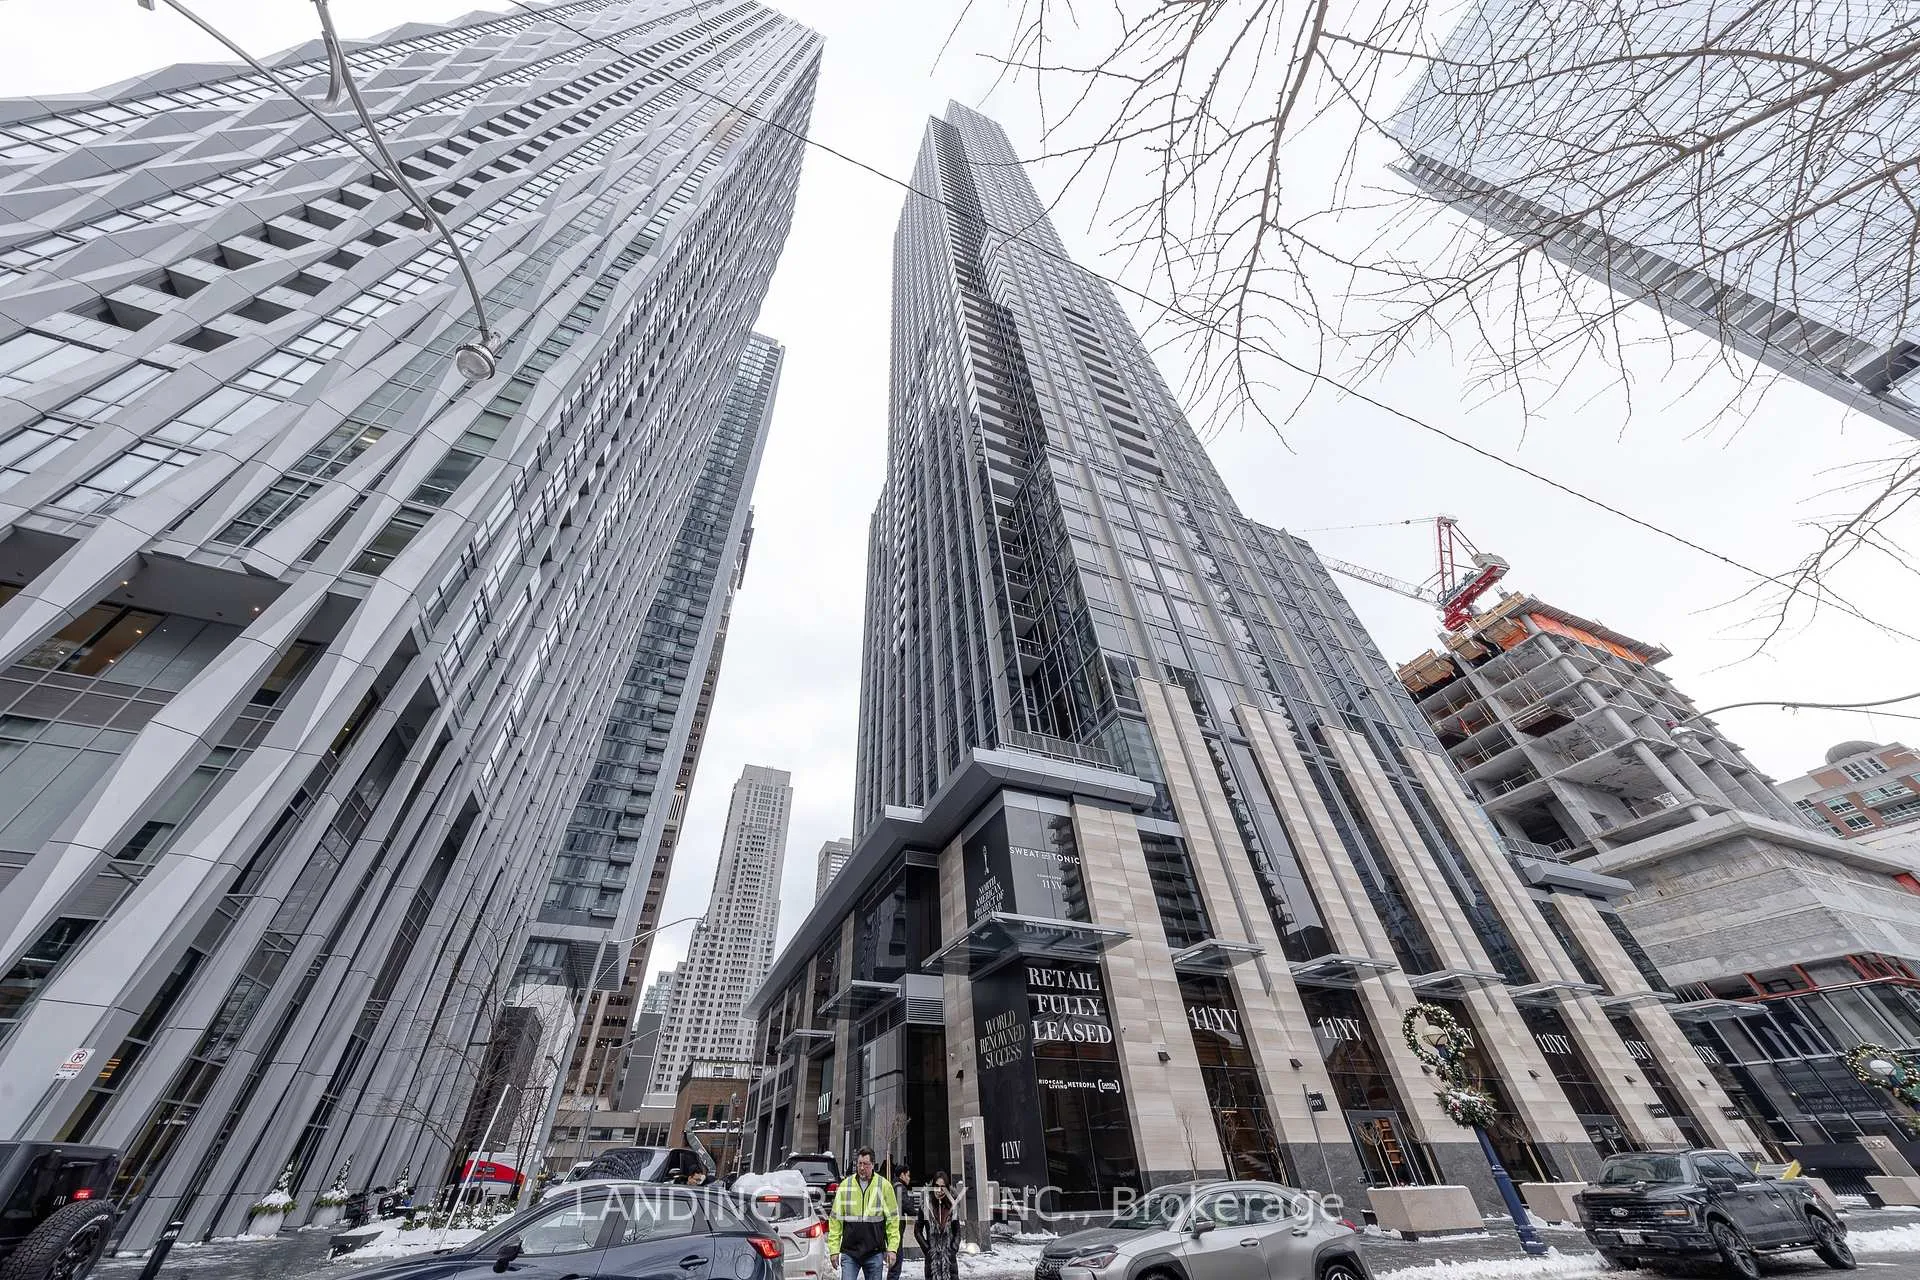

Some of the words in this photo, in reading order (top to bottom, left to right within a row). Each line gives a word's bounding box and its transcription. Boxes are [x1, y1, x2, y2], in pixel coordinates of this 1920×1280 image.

[1009, 846, 1040, 858] SWEAT
[1051, 852, 1081, 865] TONIC
[1028, 967, 1100, 991] RETAIL
[1037, 994, 1101, 1017] FULLY
[985, 1010, 1016, 1035] WORLD
[1031, 1020, 1113, 1044] LEASED
[979, 1023, 1026, 1055] RENOWNED
[985, 1043, 1022, 1069] SUCCESS
[1067, 1081, 1097, 1089] METROPIA
